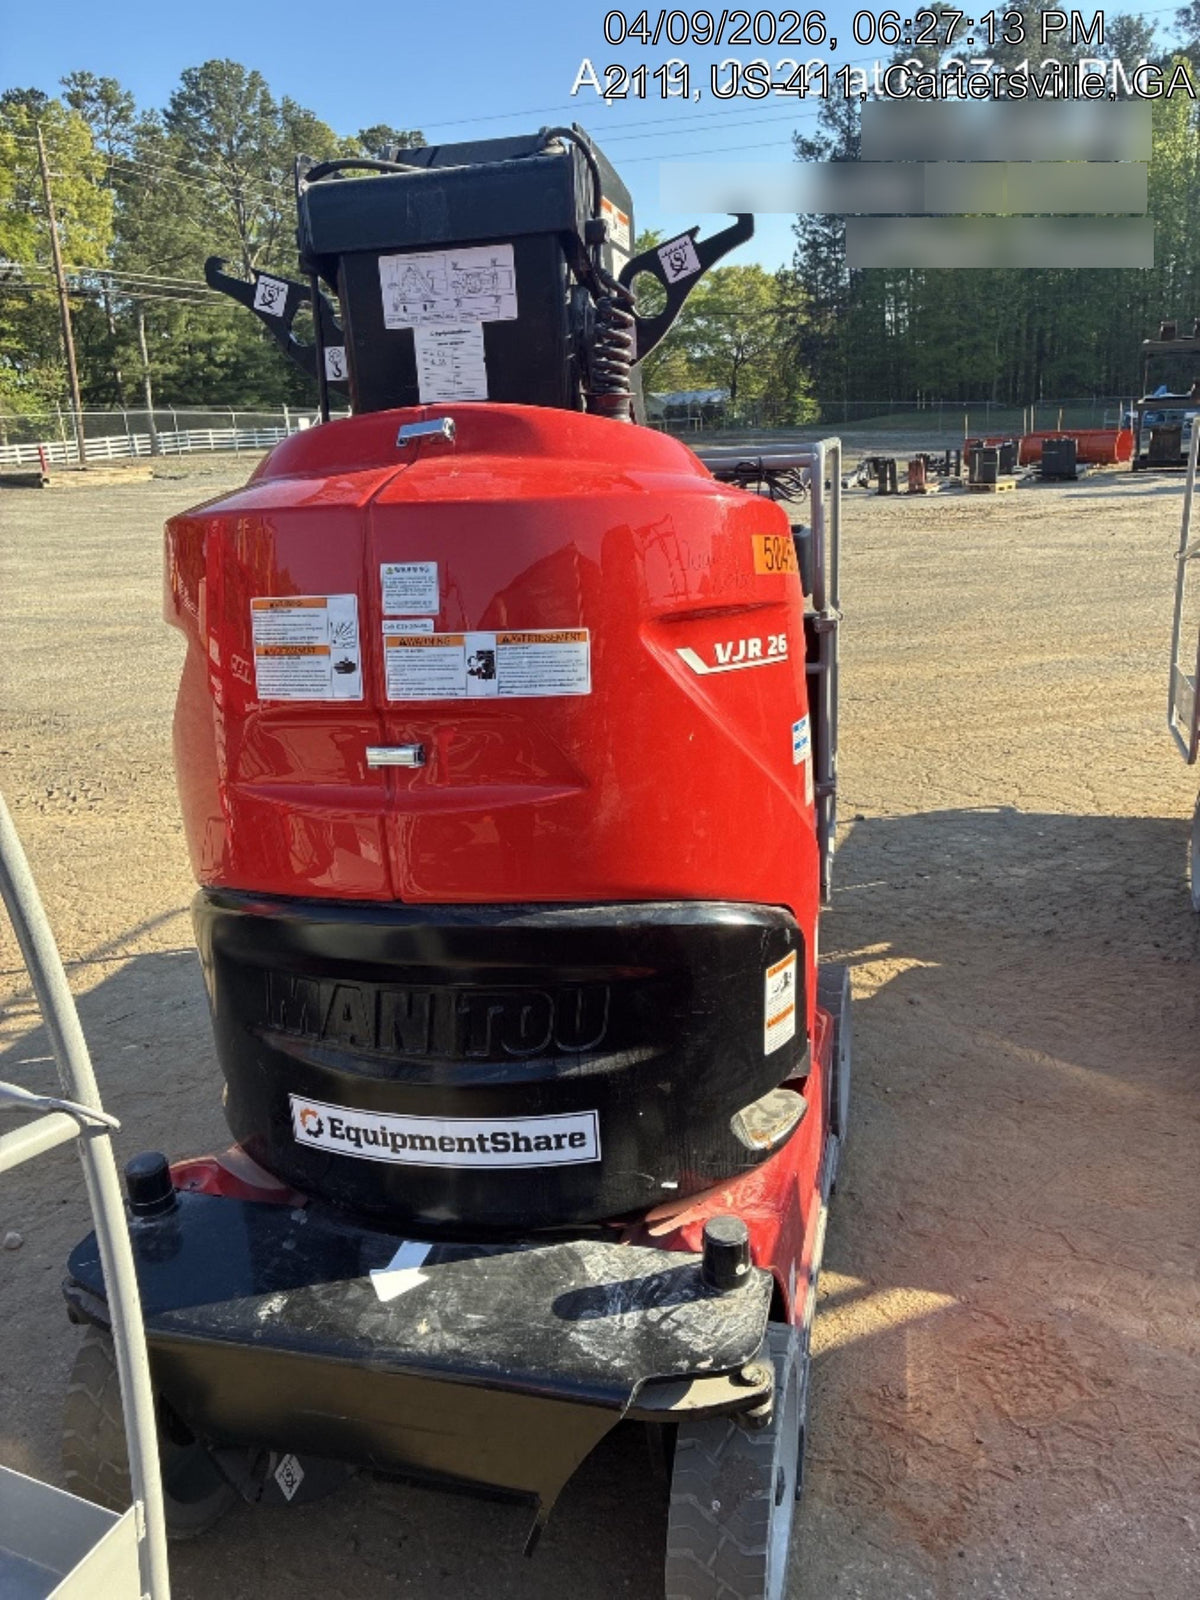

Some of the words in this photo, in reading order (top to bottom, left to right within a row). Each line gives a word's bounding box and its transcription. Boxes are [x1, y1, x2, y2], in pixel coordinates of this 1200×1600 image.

[713, 637, 763, 665] VJR
[767, 633, 788, 656] 26
[262, 970, 612, 1057] MANITOU
[326, 1116, 587, 1155] EquipmentShare
